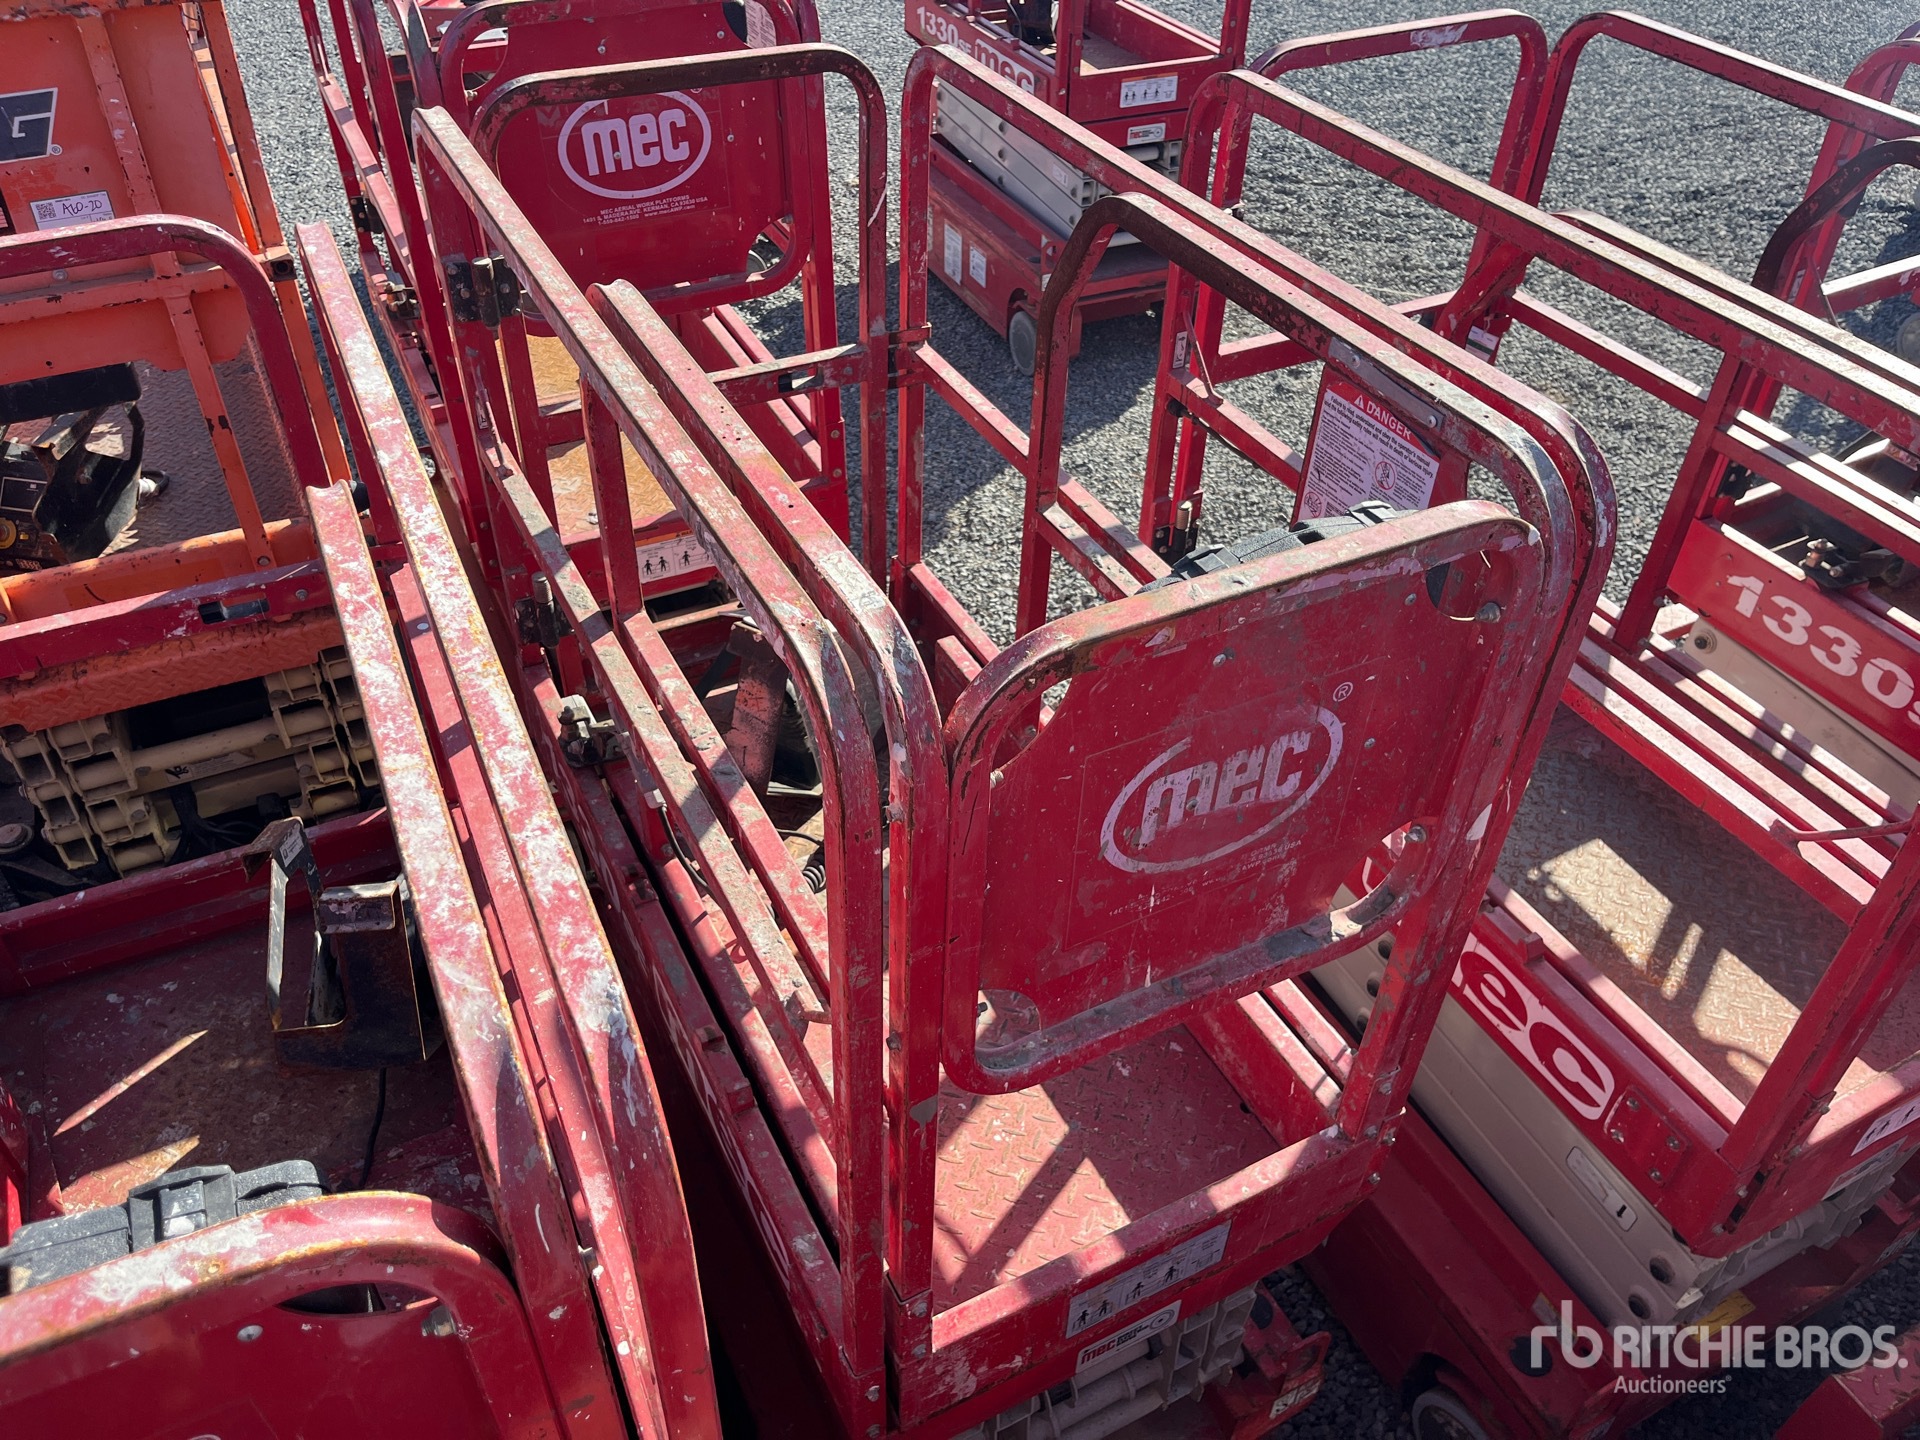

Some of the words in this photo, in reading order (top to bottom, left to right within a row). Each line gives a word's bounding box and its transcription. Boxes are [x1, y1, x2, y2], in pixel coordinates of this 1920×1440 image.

[614, 204, 636, 213] AERIAL
[636, 200, 654, 208] WORK
[655, 195, 690, 205] PLATFORMS
[1355, 414, 1375, 429] understand
[1382, 431, 1391, 442] obey
[1366, 400, 1412, 440] DANGER
[1337, 407, 1352, 423] following
[1352, 419, 1363, 430] safety
[1363, 426, 1371, 435] rules
[1379, 437, 1389, 447] result
[1393, 447, 1404, 457] death
[1409, 457, 1422, 470] serious
